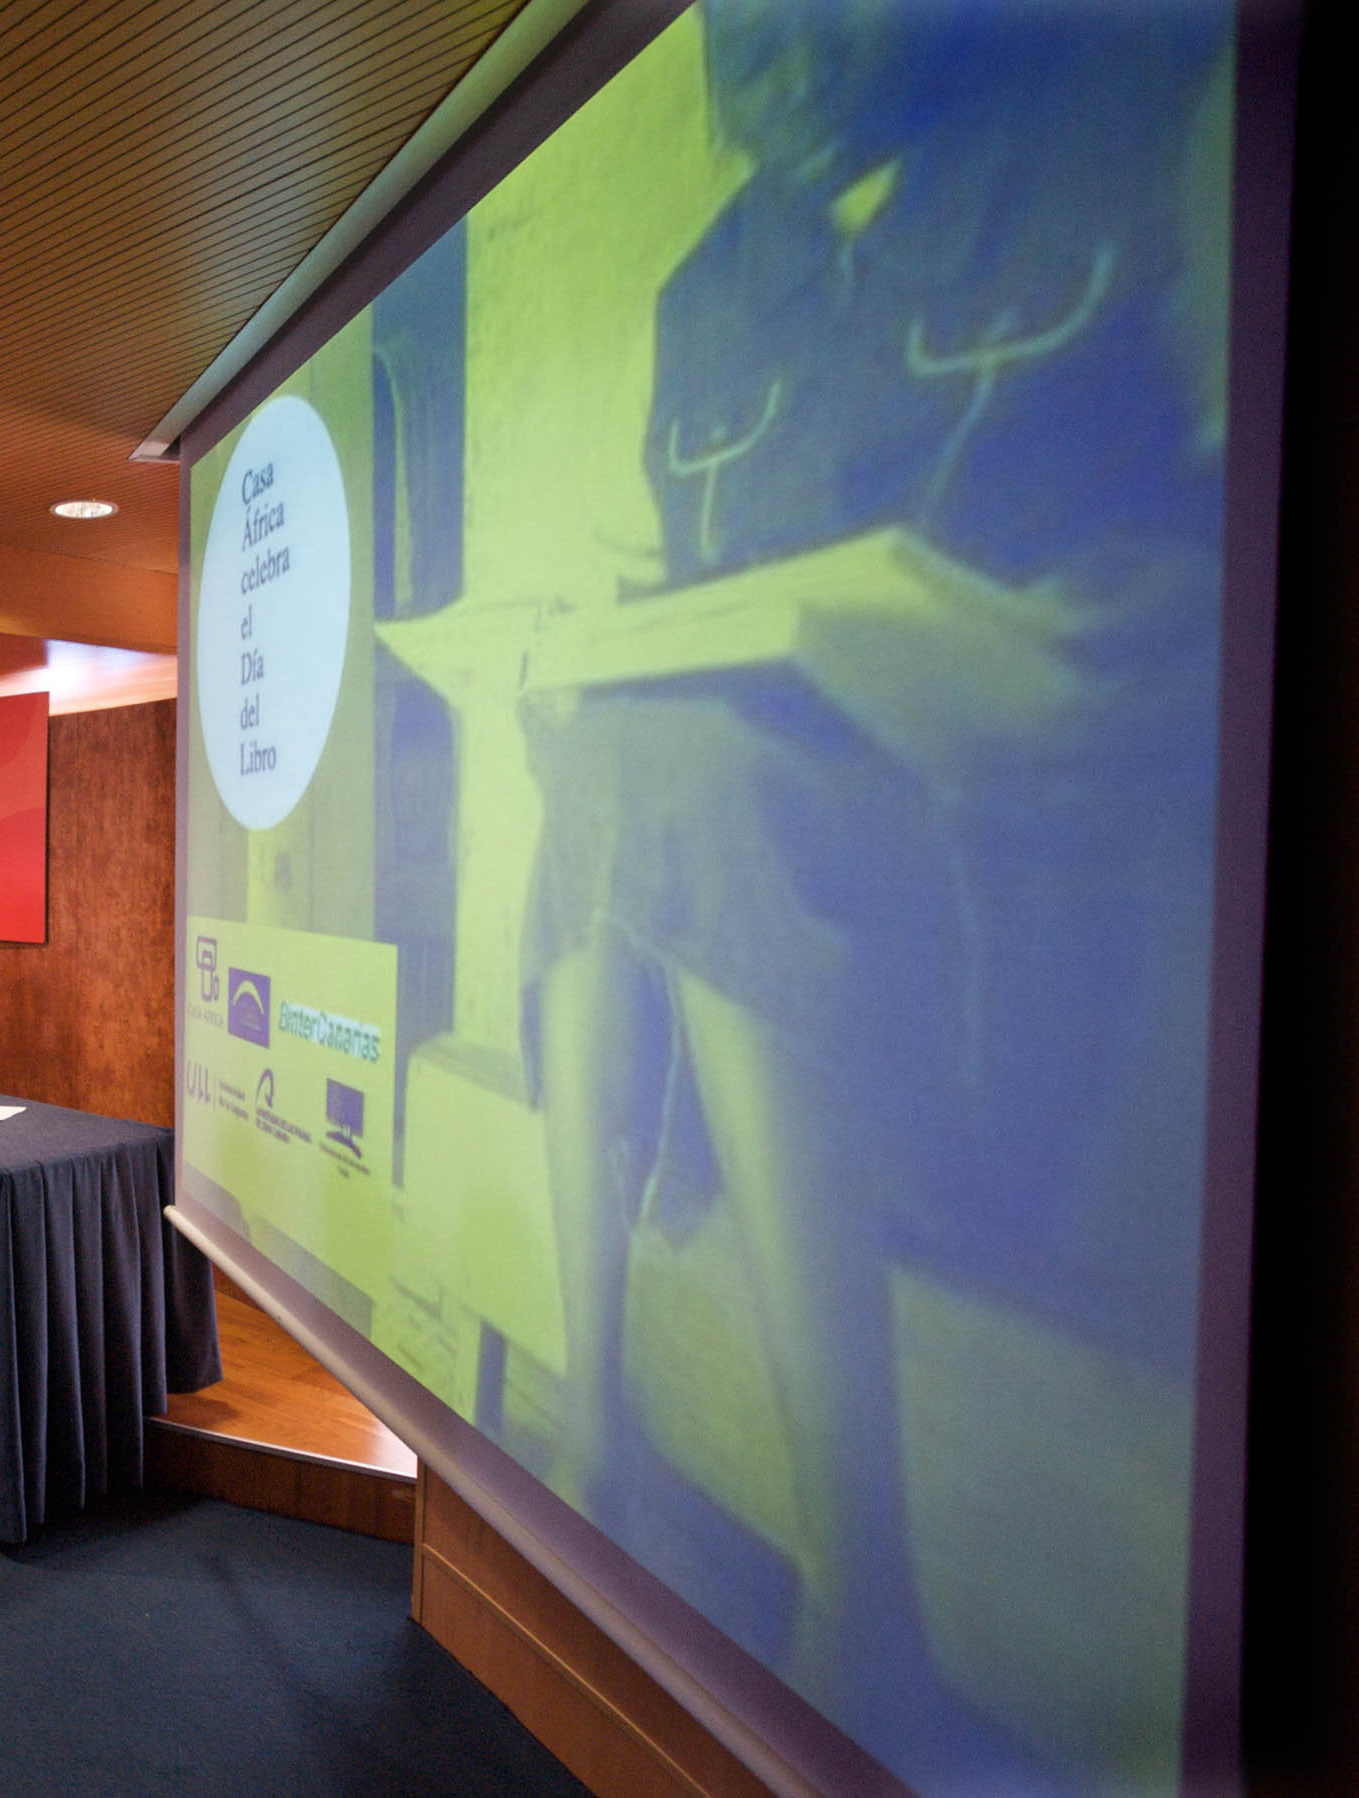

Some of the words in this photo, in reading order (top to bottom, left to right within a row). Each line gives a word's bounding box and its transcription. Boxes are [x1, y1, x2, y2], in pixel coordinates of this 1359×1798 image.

[242, 461, 274, 505] Casa
[242, 501, 285, 552] África
[241, 546, 291, 595] celebra
[241, 603, 253, 640] el
[241, 648, 264, 686] Día
[240, 692, 260, 731] del
[240, 740, 277, 776] Libro
